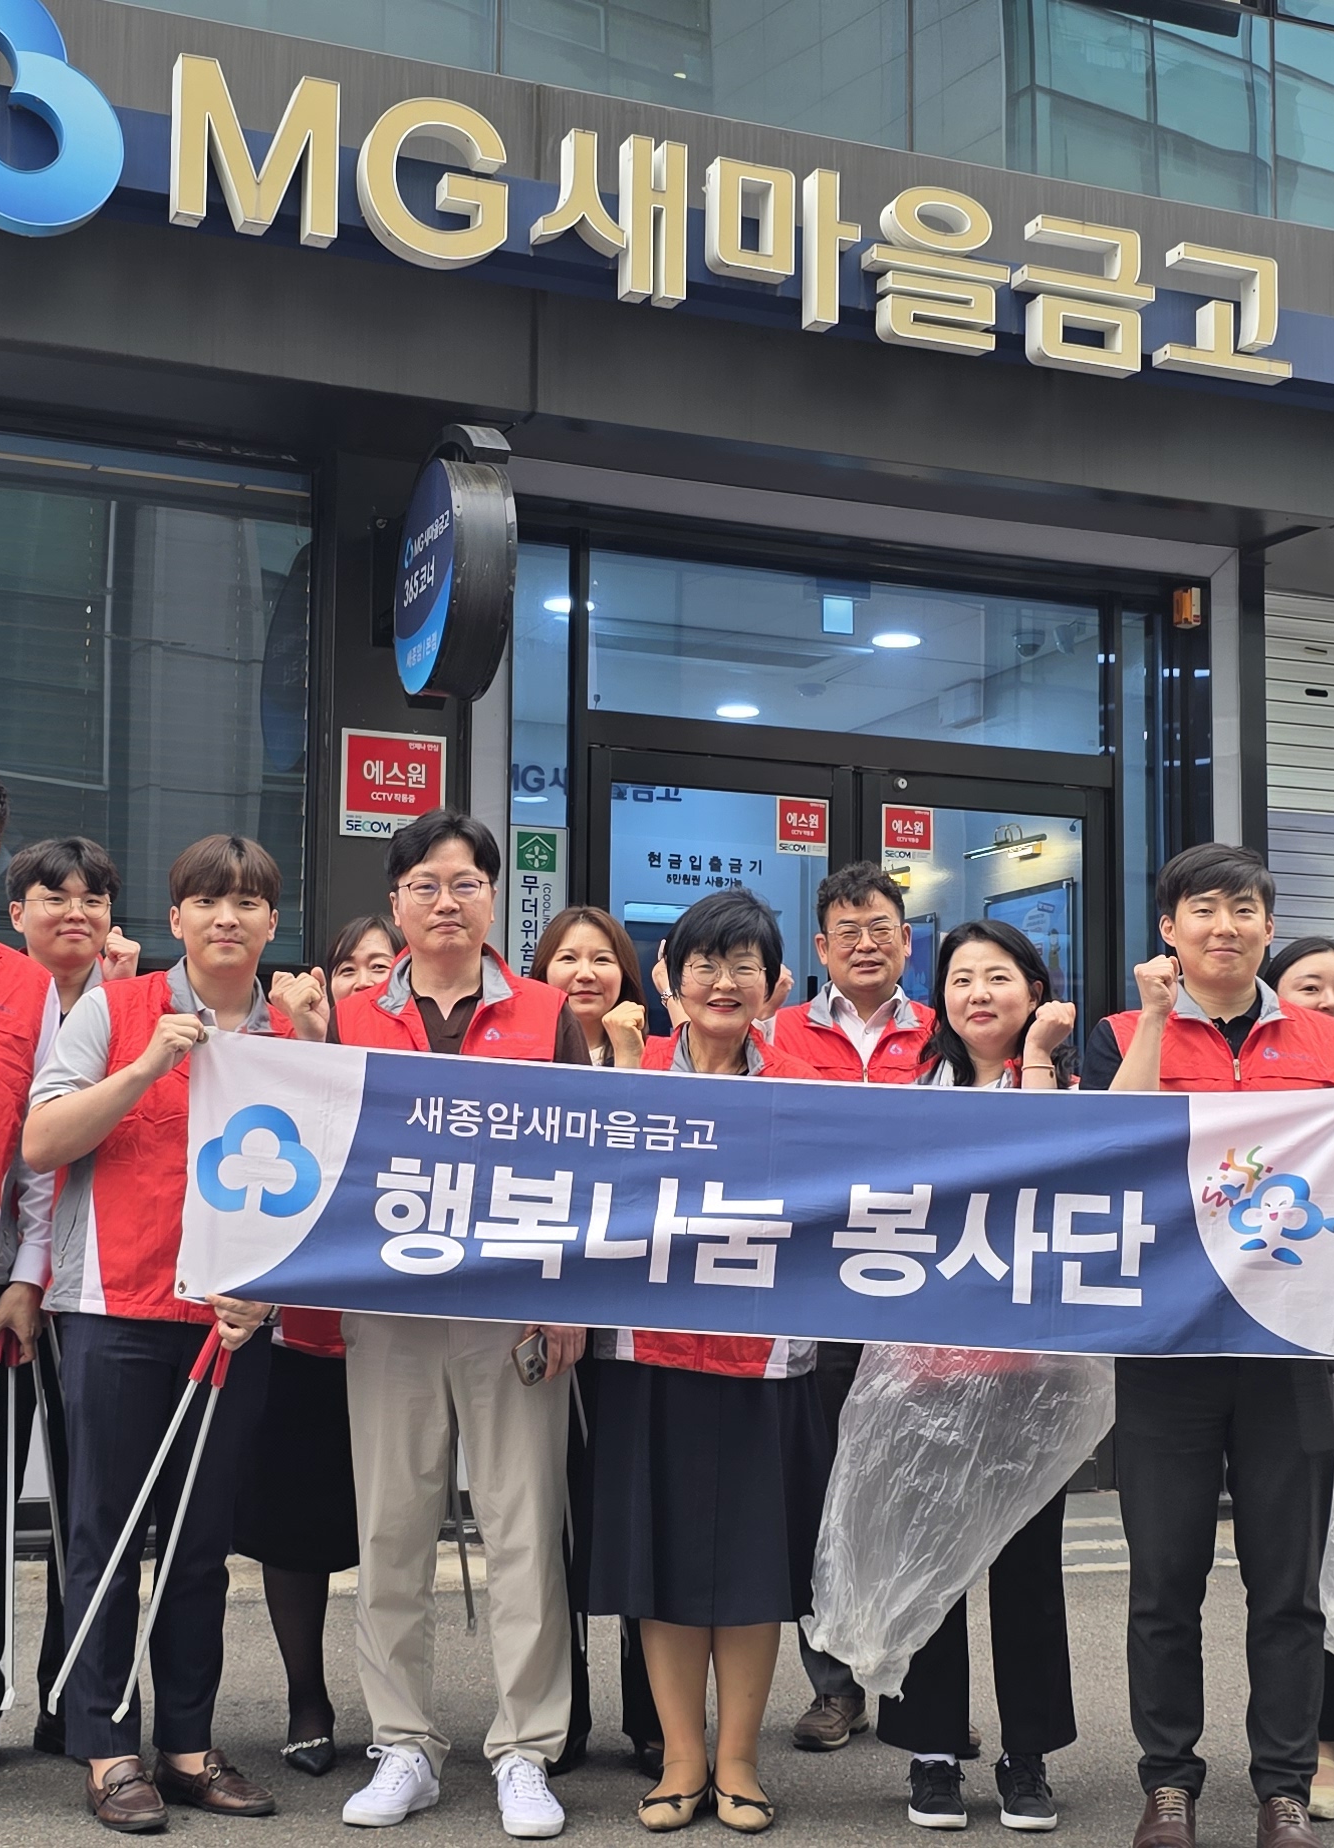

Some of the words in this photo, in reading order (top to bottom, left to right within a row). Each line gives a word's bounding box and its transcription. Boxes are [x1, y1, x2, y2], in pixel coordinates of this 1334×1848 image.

[169, 52, 1293, 386] MG새마을금고
[413, 509, 450, 557] MG새마을금고
[363, 759, 426, 789] 에스원
[370, 791, 393, 802] CCTV
[346, 819, 392, 834] SECOM
[786, 811, 819, 829] 에스원
[891, 819, 924, 836] 에스원
[779, 843, 806, 853] SECOM
[885, 850, 911, 860] SECOM
[647, 851, 762, 876] 현금입출금기
[405, 1093, 720, 1153] 새종암새마을금고
[373, 1155, 794, 1292] 행복나눔
[830, 1182, 1157, 1309] 봉사단
